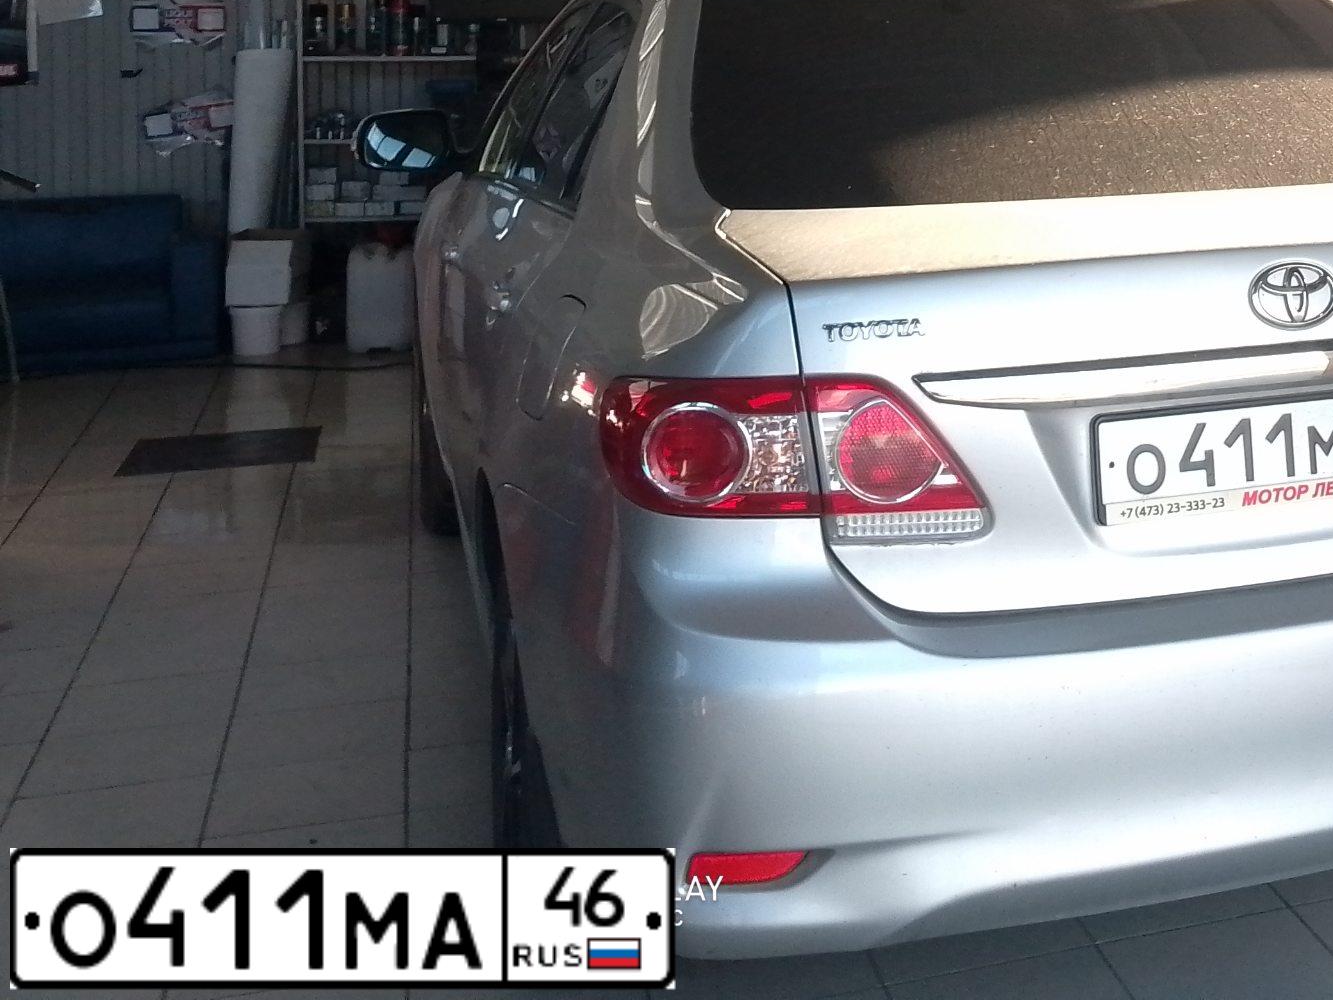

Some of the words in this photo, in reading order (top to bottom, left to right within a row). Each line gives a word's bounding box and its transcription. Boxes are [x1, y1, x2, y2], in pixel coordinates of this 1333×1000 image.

[822, 318, 925, 342] TOYOTA
[1241, 484, 1309, 507] МОТОР
[1135, 504, 1164, 519] (473)
[1167, 497, 1225, 515] 23-333-23
